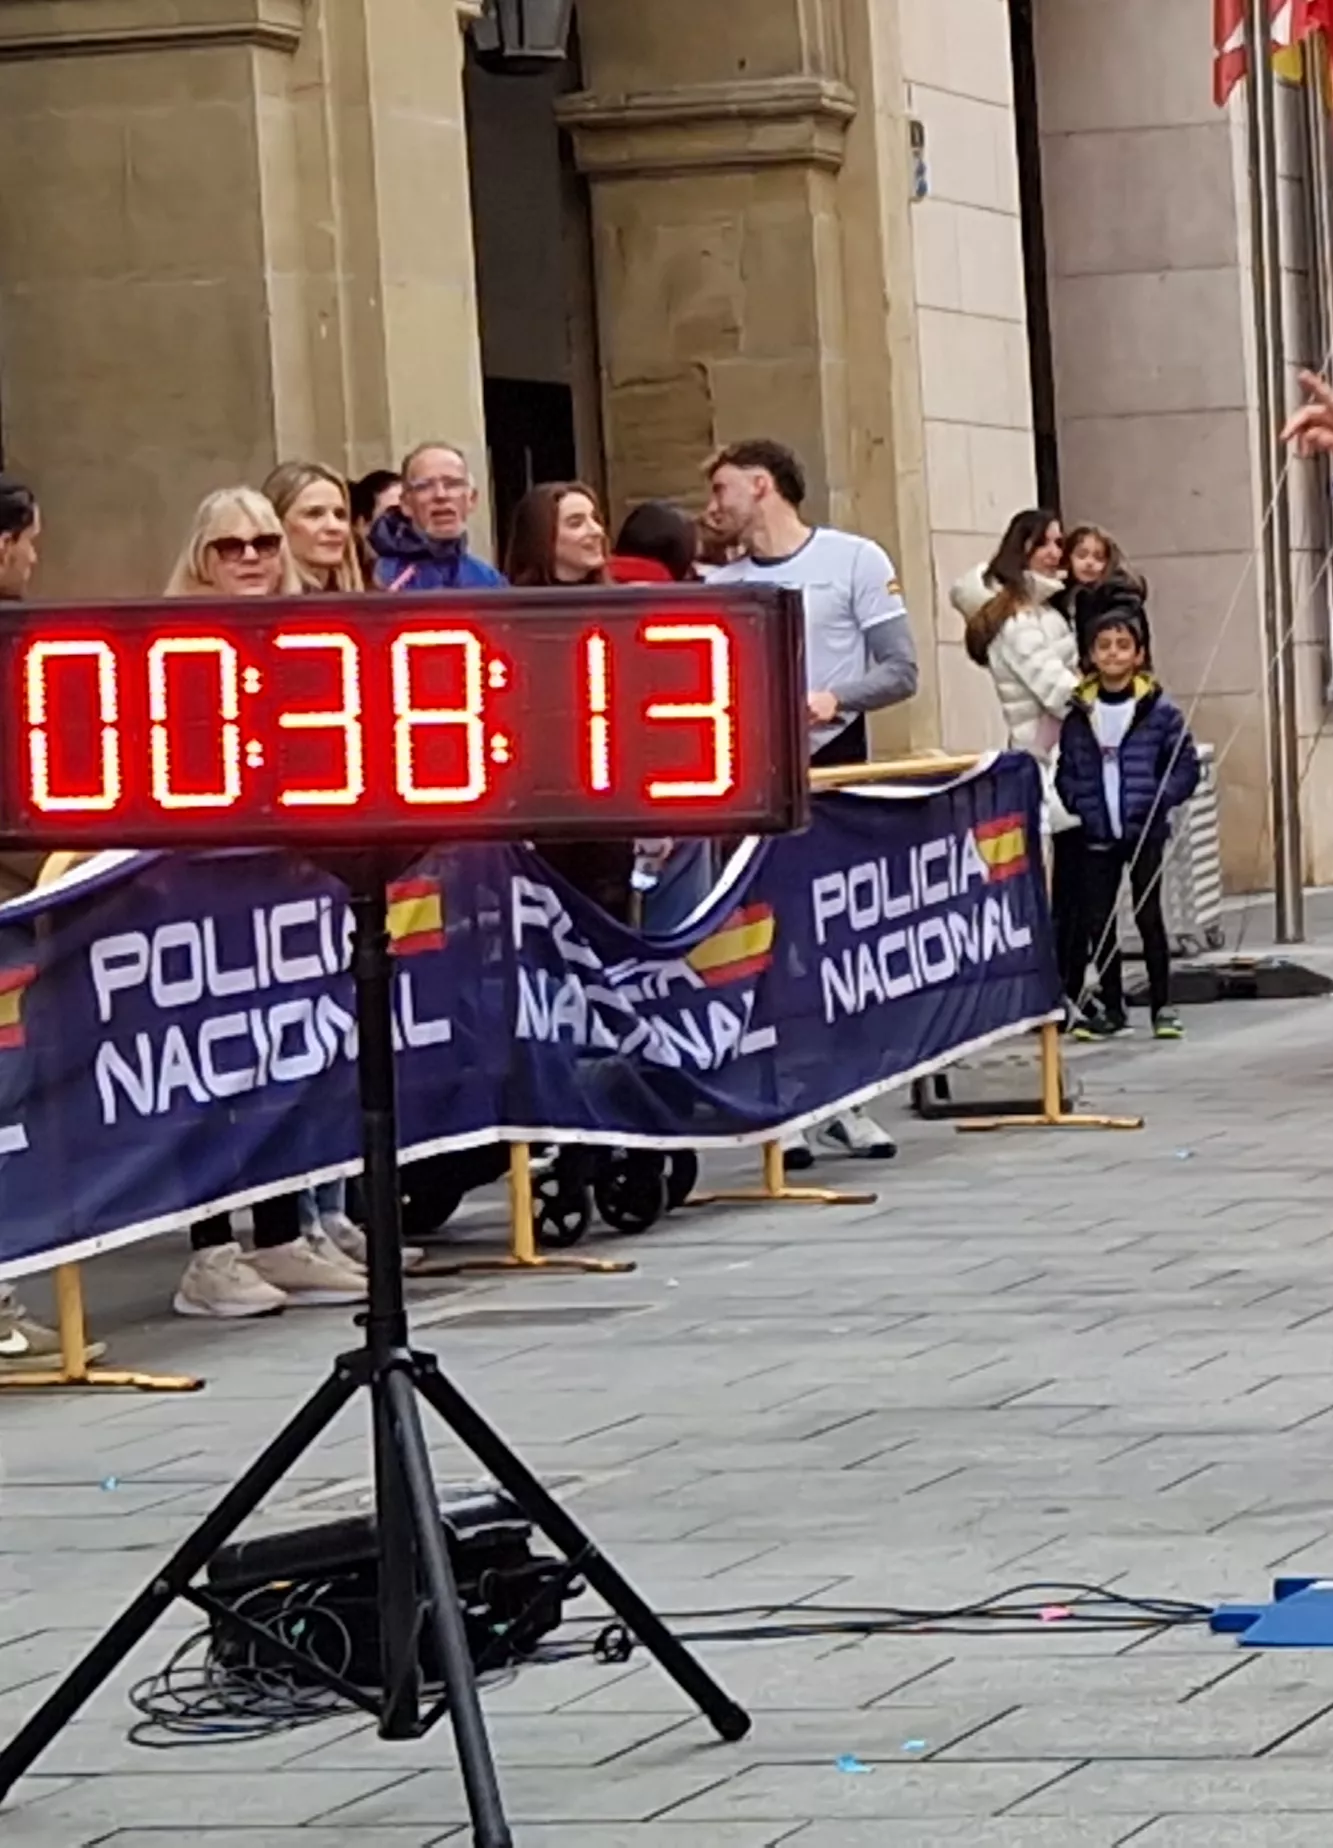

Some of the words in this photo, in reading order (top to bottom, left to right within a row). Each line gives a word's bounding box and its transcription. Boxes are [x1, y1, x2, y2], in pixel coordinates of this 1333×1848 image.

[25, 624, 734, 811] 00:38:13
[821, 891, 1033, 1024] NACIONAL
[95, 972, 452, 1125] NACIONL
